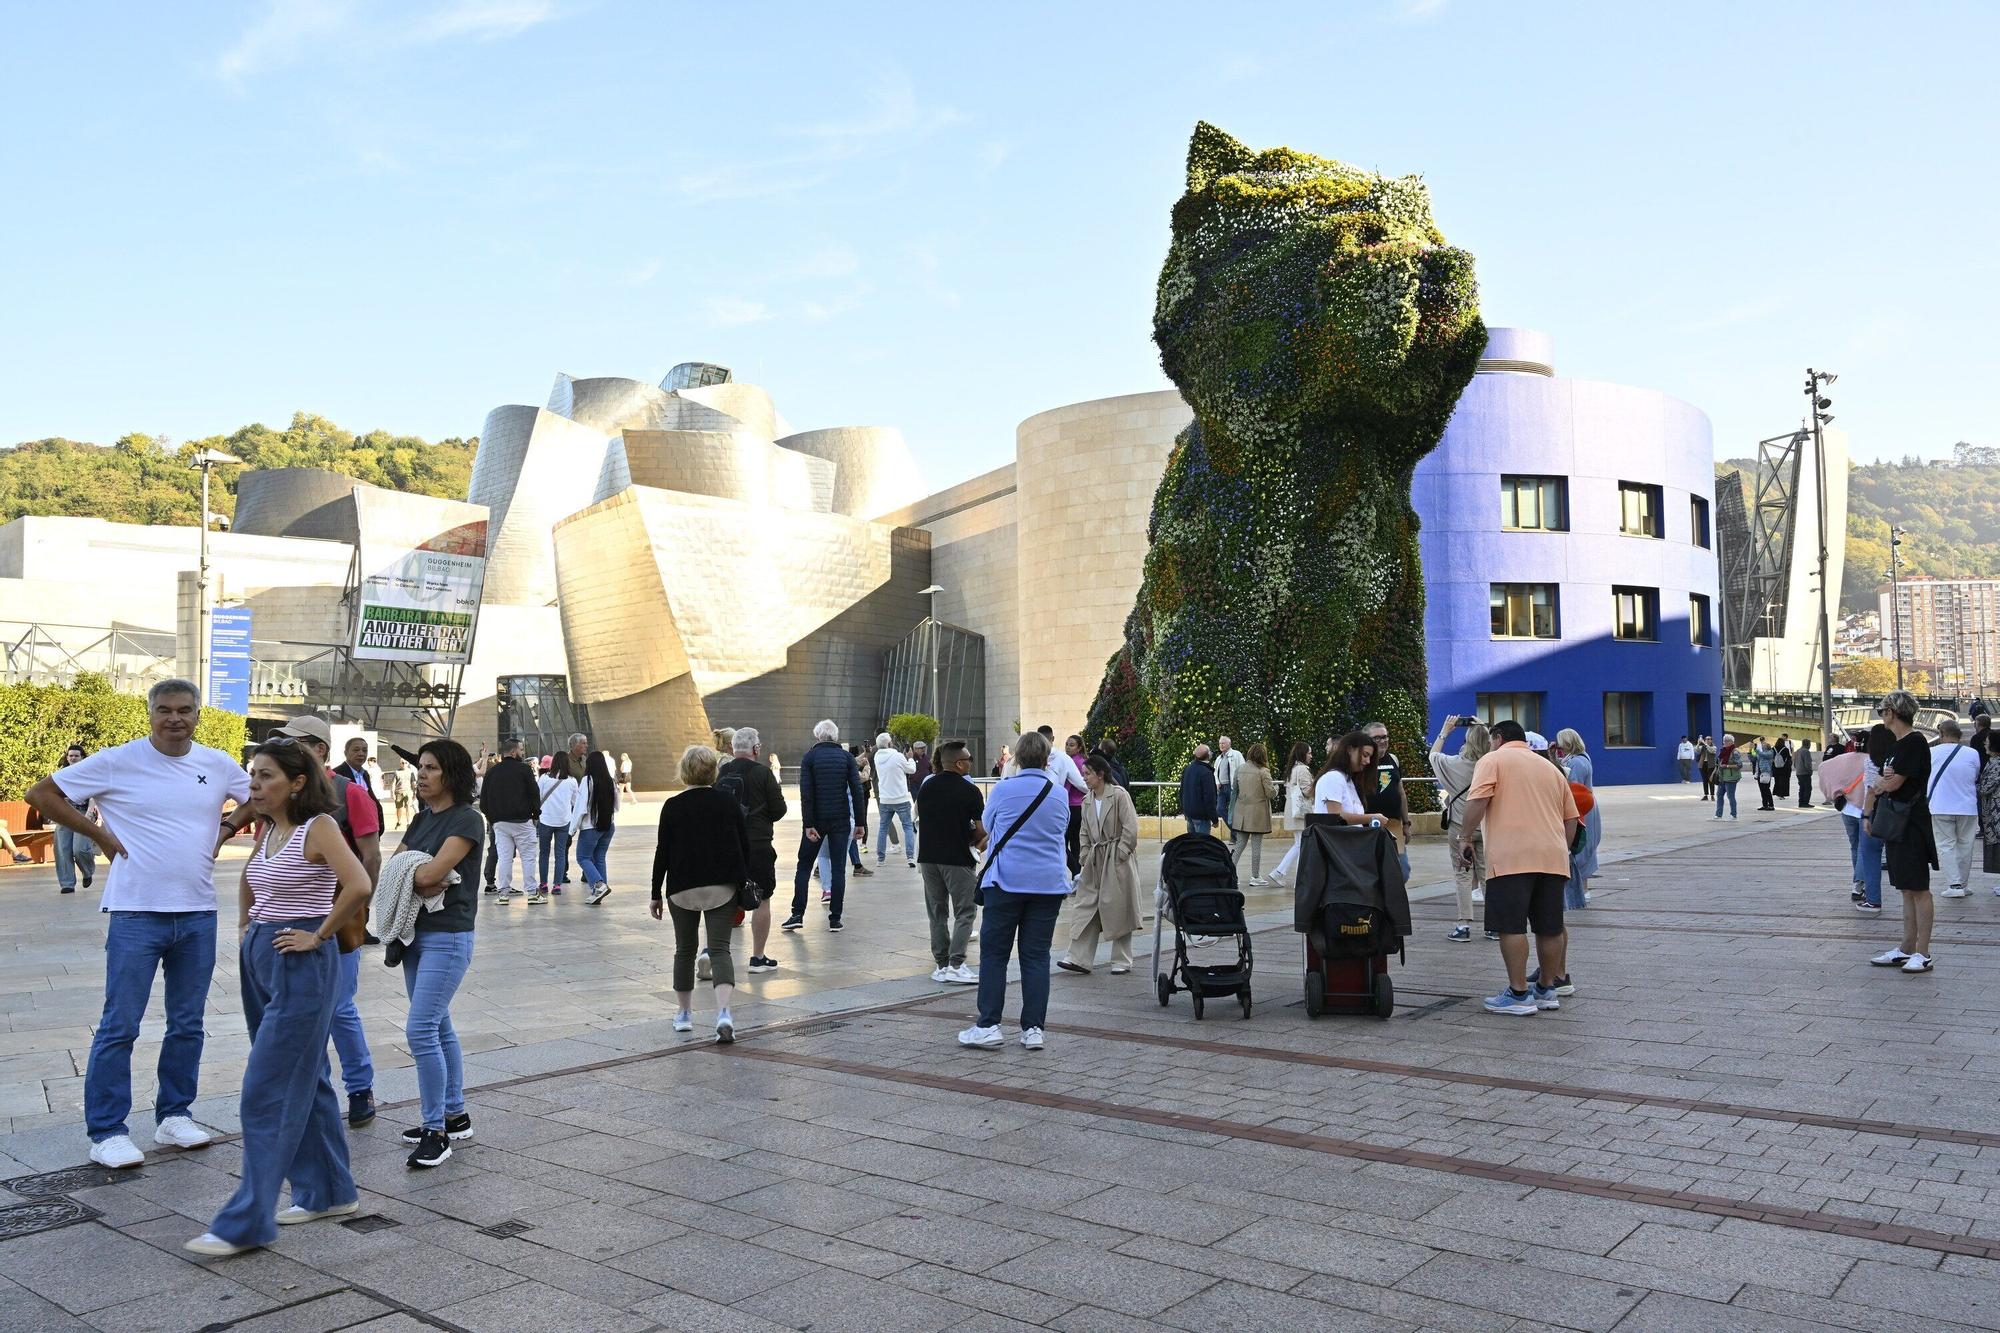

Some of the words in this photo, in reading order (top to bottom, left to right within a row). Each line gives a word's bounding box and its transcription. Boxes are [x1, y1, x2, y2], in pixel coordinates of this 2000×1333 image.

[427, 558, 472, 568] GUGGENHEIM
[366, 606, 421, 623] BARBARA
[364, 620, 435, 637] ANOTHER
[440, 626, 467, 639] DAY
[361, 633, 423, 649] ANOTHER
[426, 638, 466, 652] NIGHT
[1340, 924, 1369, 935] PUMA
